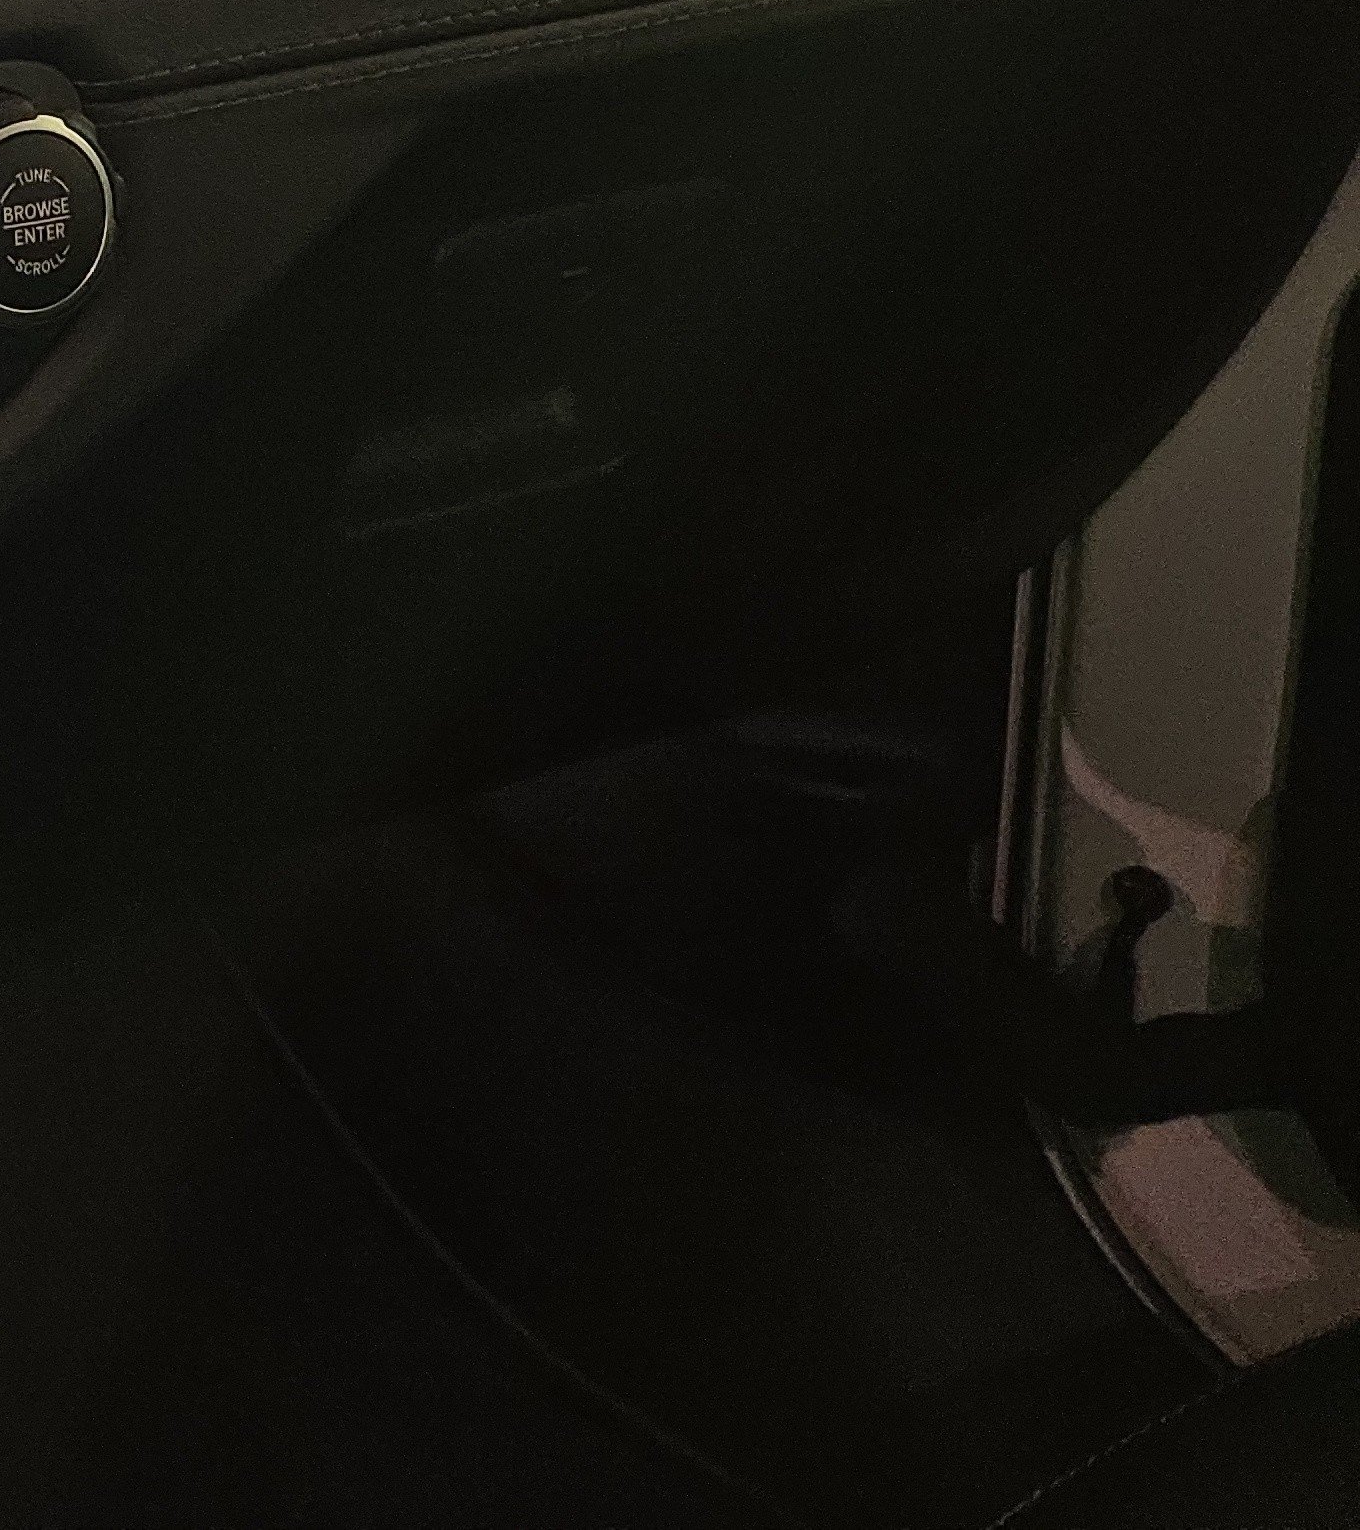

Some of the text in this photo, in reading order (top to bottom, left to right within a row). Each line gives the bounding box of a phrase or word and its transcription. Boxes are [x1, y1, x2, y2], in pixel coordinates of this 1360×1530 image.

[15, 168, 53, 186] TUNE
[3, 196, 70, 223] BROWSE
[14, 222, 66, 247] ENTER
[15, 253, 67, 276] SCROLL
